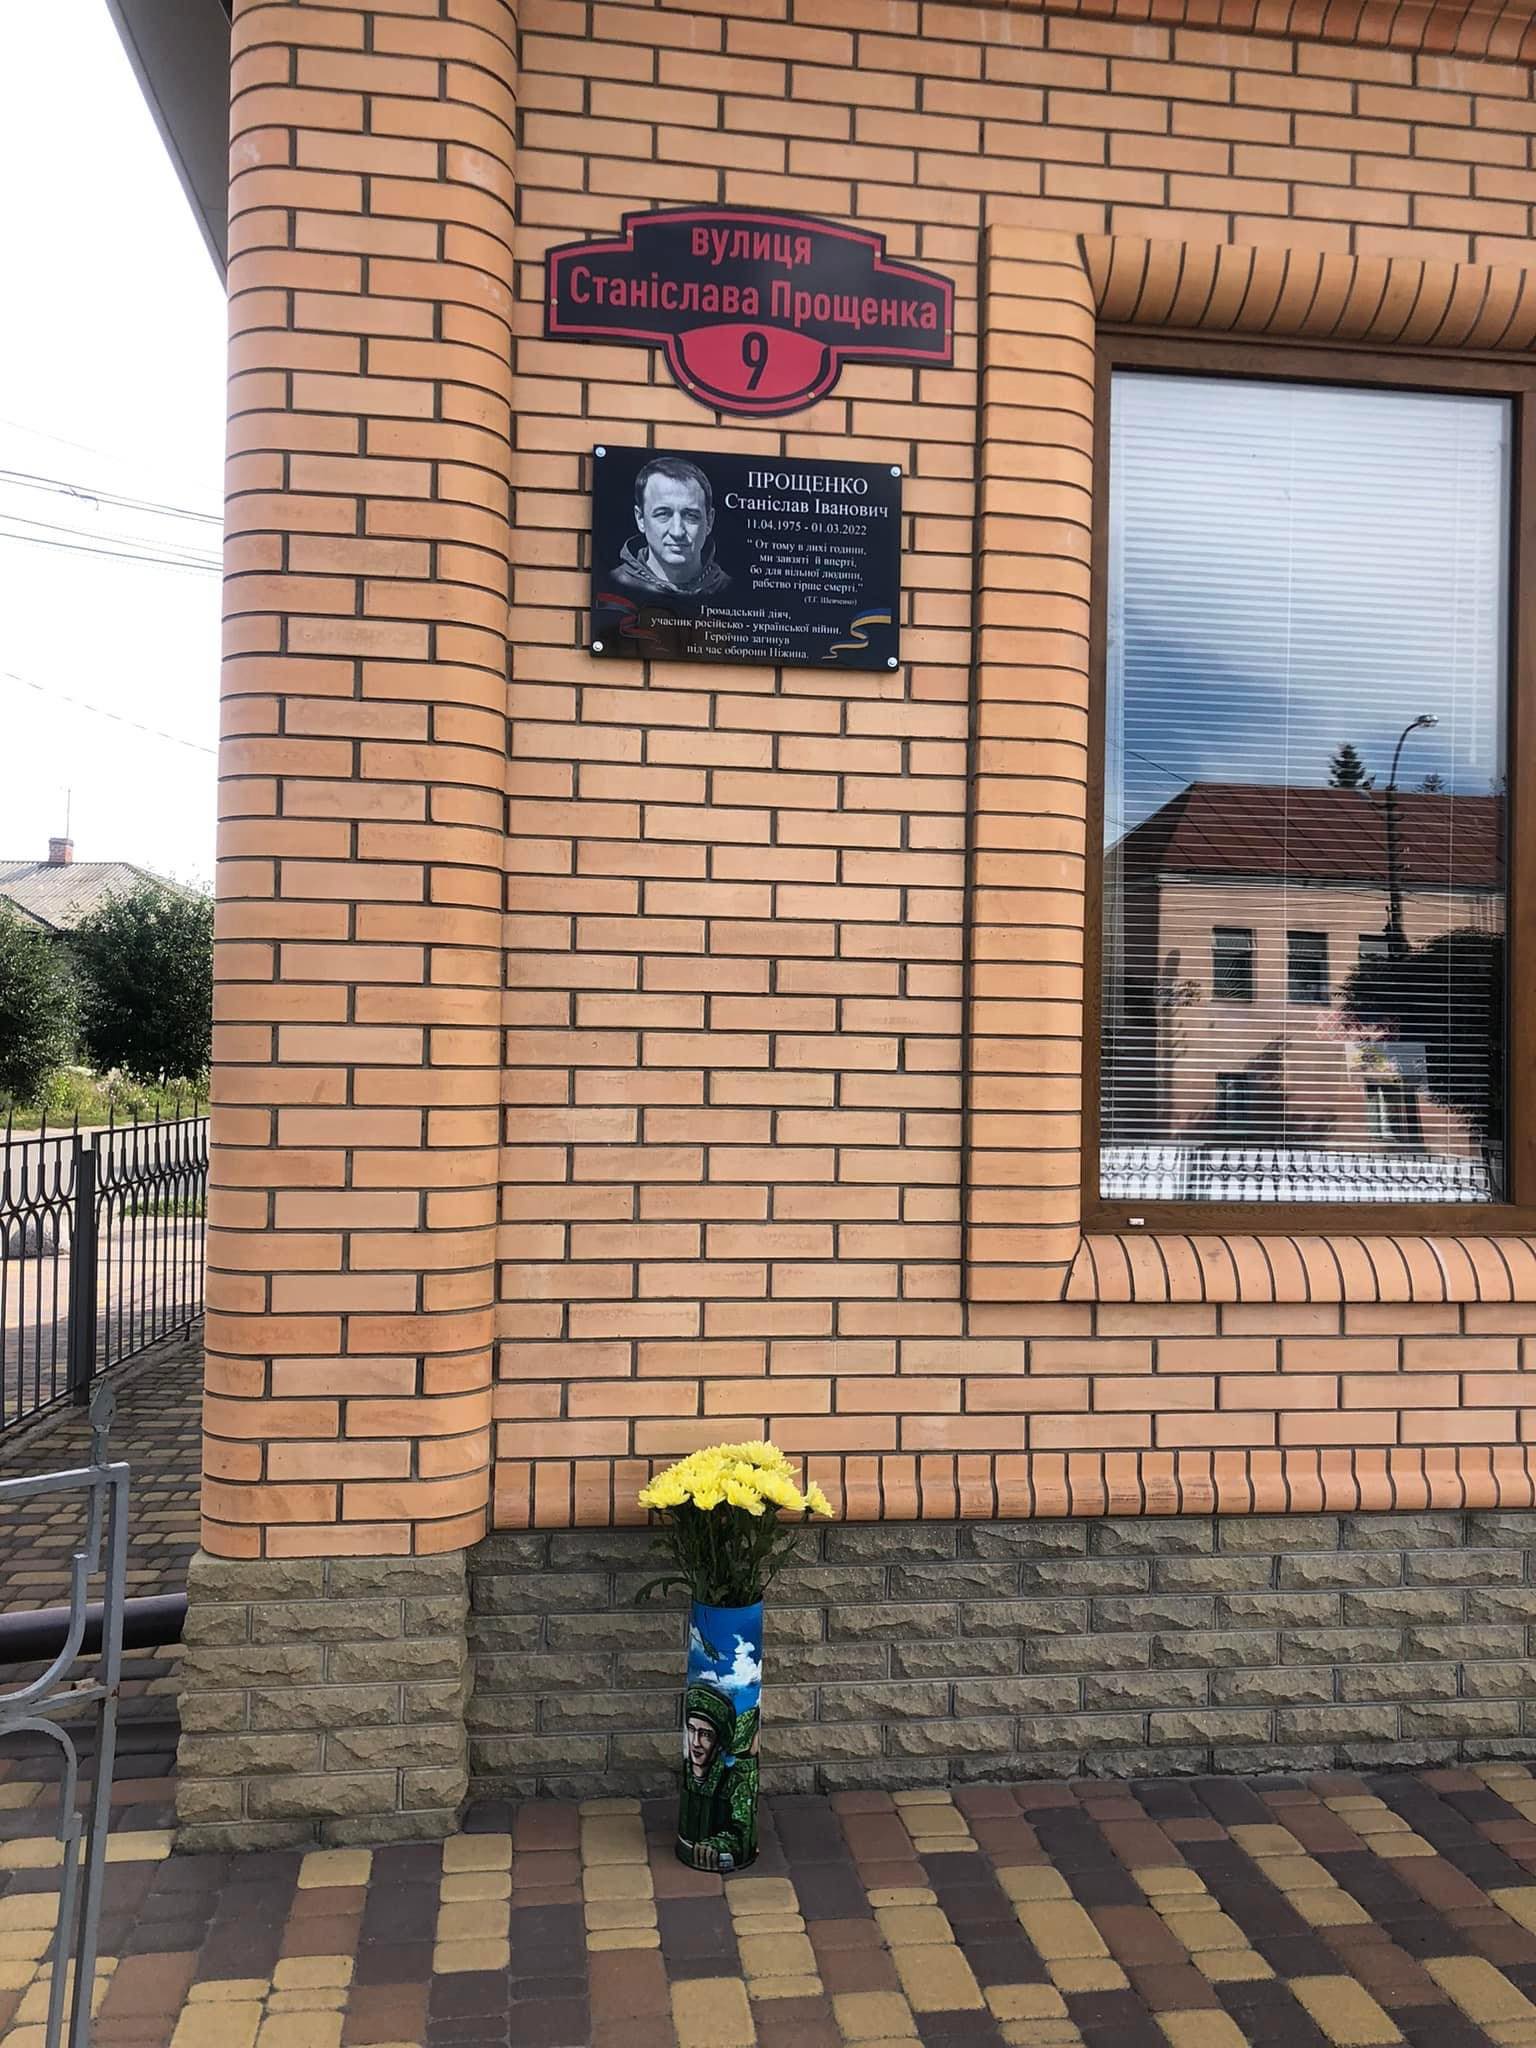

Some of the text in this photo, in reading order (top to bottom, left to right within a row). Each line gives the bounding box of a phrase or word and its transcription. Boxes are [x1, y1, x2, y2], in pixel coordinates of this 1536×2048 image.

[691, 226, 812, 269] вулиця
[570, 266, 937, 330] Станіслава Прощенка
[741, 331, 769, 391] 9
[748, 471, 868, 495] ПРОЩЕНКО
[725, 493, 888, 518] Станіслав Іванович
[747, 519, 801, 532] 11.04.1975
[811, 522, 867, 536] 01.03.2022
[772, 541, 795, 553] тому
[806, 542, 827, 553] лихі
[829, 545, 867, 556] години,
[760, 554, 773, 563] ми
[750, 565, 863, 581] бо для вільної людини,
[752, 578, 791, 590] рабство
[793, 580, 821, 592] гірше
[701, 604, 792, 620] Громадський діяч,
[650, 616, 692, 628] учасник
[694, 618, 744, 630] російсько
[752, 621, 809, 633] української
[704, 631, 749, 644] Героїчно
[687, 643, 808, 659] під час оборони Ніжина.
